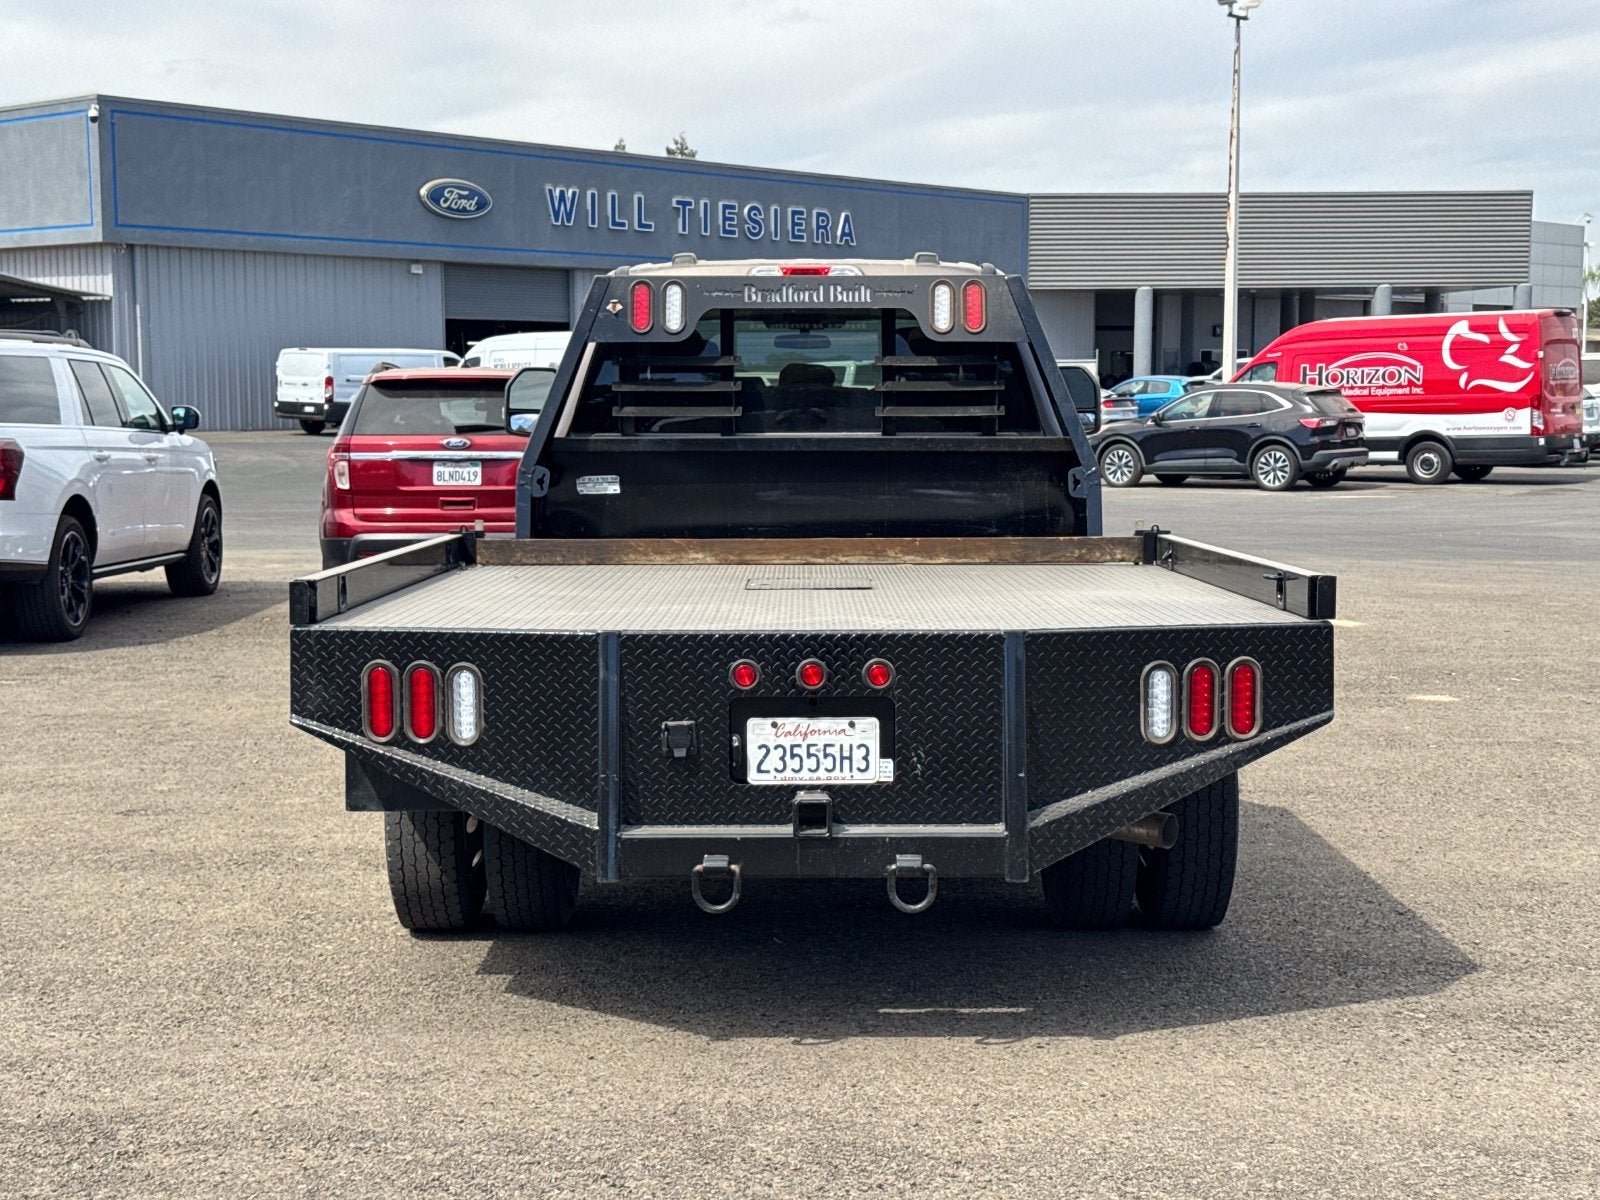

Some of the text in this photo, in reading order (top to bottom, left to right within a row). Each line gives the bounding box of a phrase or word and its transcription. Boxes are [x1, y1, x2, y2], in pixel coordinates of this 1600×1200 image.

[440, 187, 479, 211] Ford
[545, 184, 857, 247] WILL TIESIERA
[743, 283, 873, 303] Bradford Built
[1300, 363, 1424, 388] HORIZON
[1341, 386, 1425, 397] Medical Equipment Inc.
[436, 470, 479, 482] 8LND419
[774, 722, 855, 742] California
[756, 743, 871, 774] 23555H3
